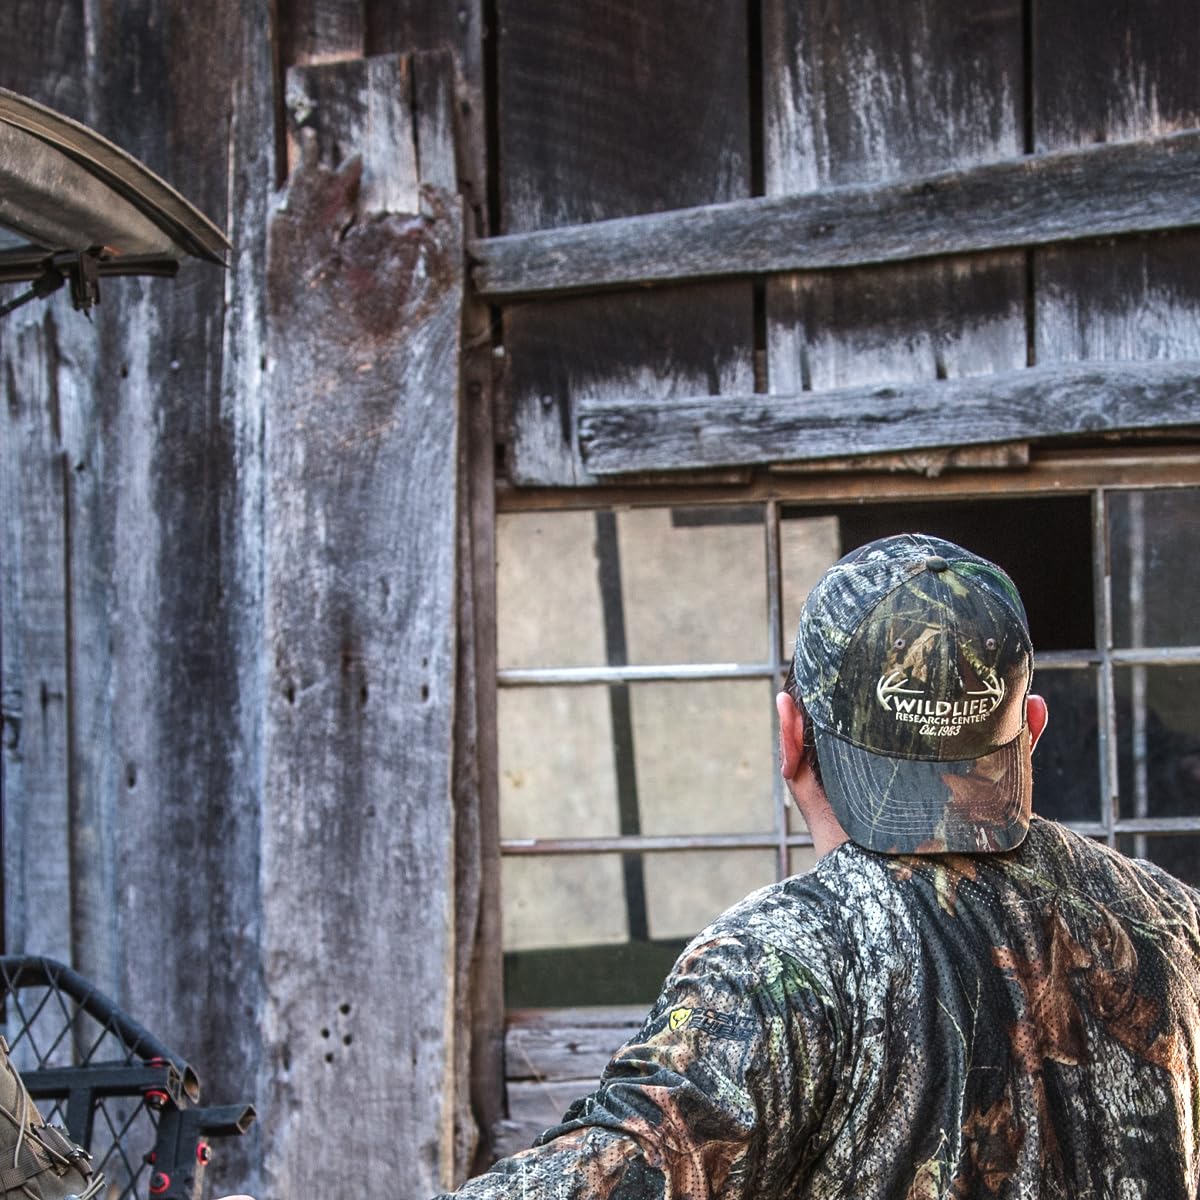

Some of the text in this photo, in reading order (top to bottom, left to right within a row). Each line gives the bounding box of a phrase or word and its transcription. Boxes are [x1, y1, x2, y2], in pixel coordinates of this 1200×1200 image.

[893, 695, 989, 716] WILDLIFE
[895, 711, 949, 725] RESEARCH
[937, 725, 961, 736] 1983
